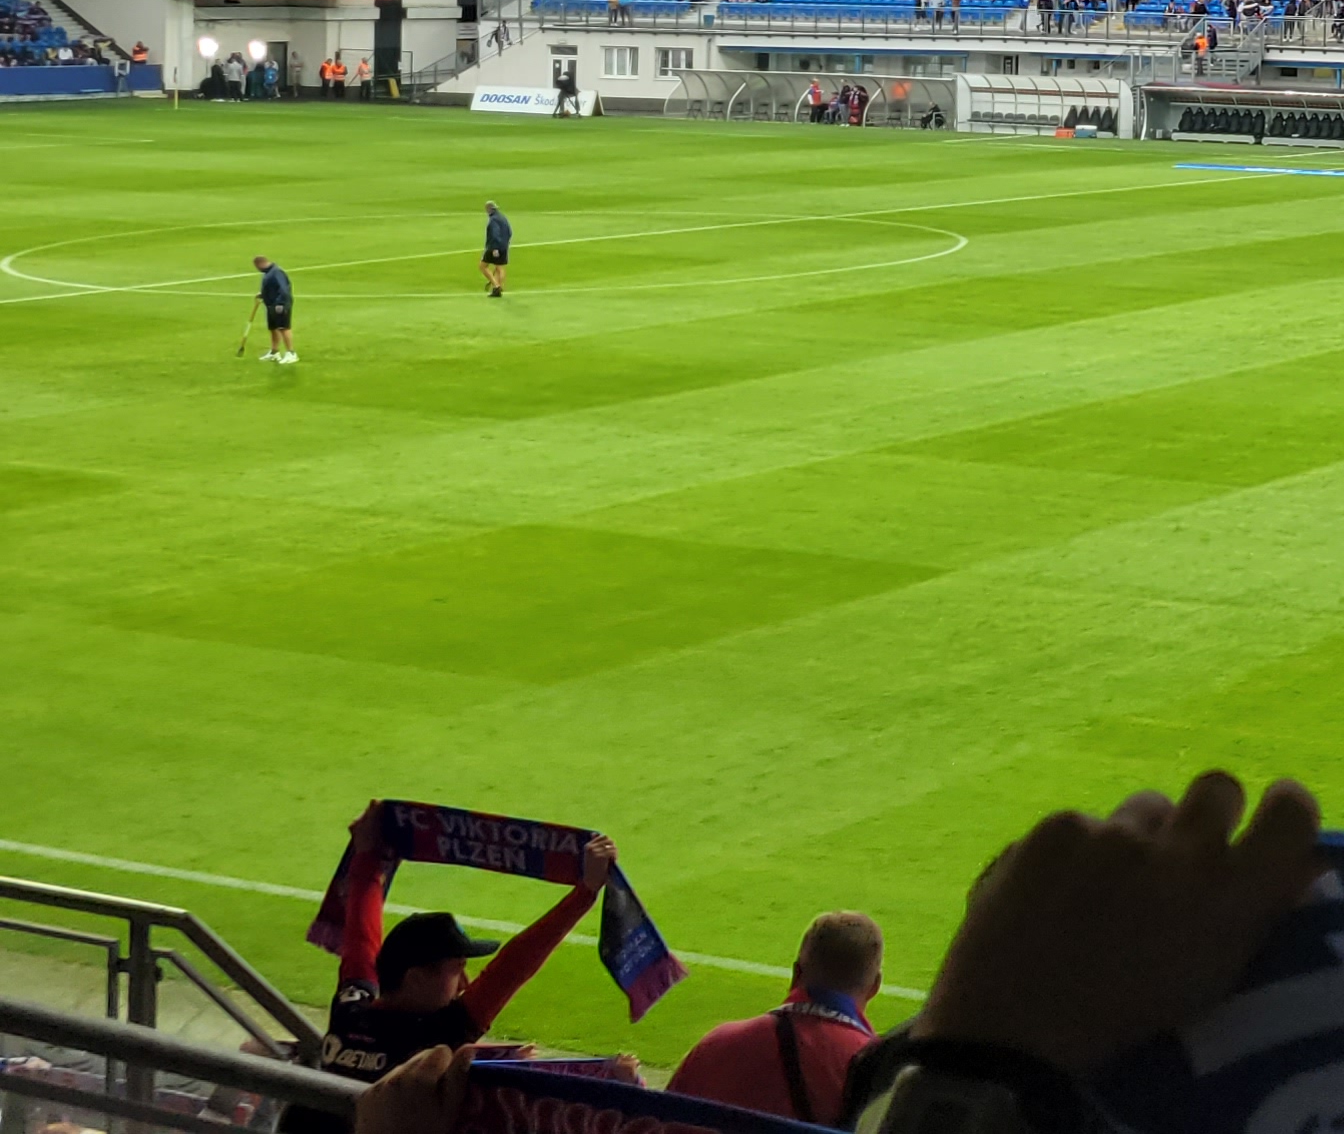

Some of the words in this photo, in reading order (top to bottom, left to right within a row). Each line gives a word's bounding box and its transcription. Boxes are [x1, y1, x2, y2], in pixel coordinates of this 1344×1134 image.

[480, 93, 531, 105] DOOSAN
[393, 805, 431, 831] FC
[435, 812, 579, 855] VIKTORIA
